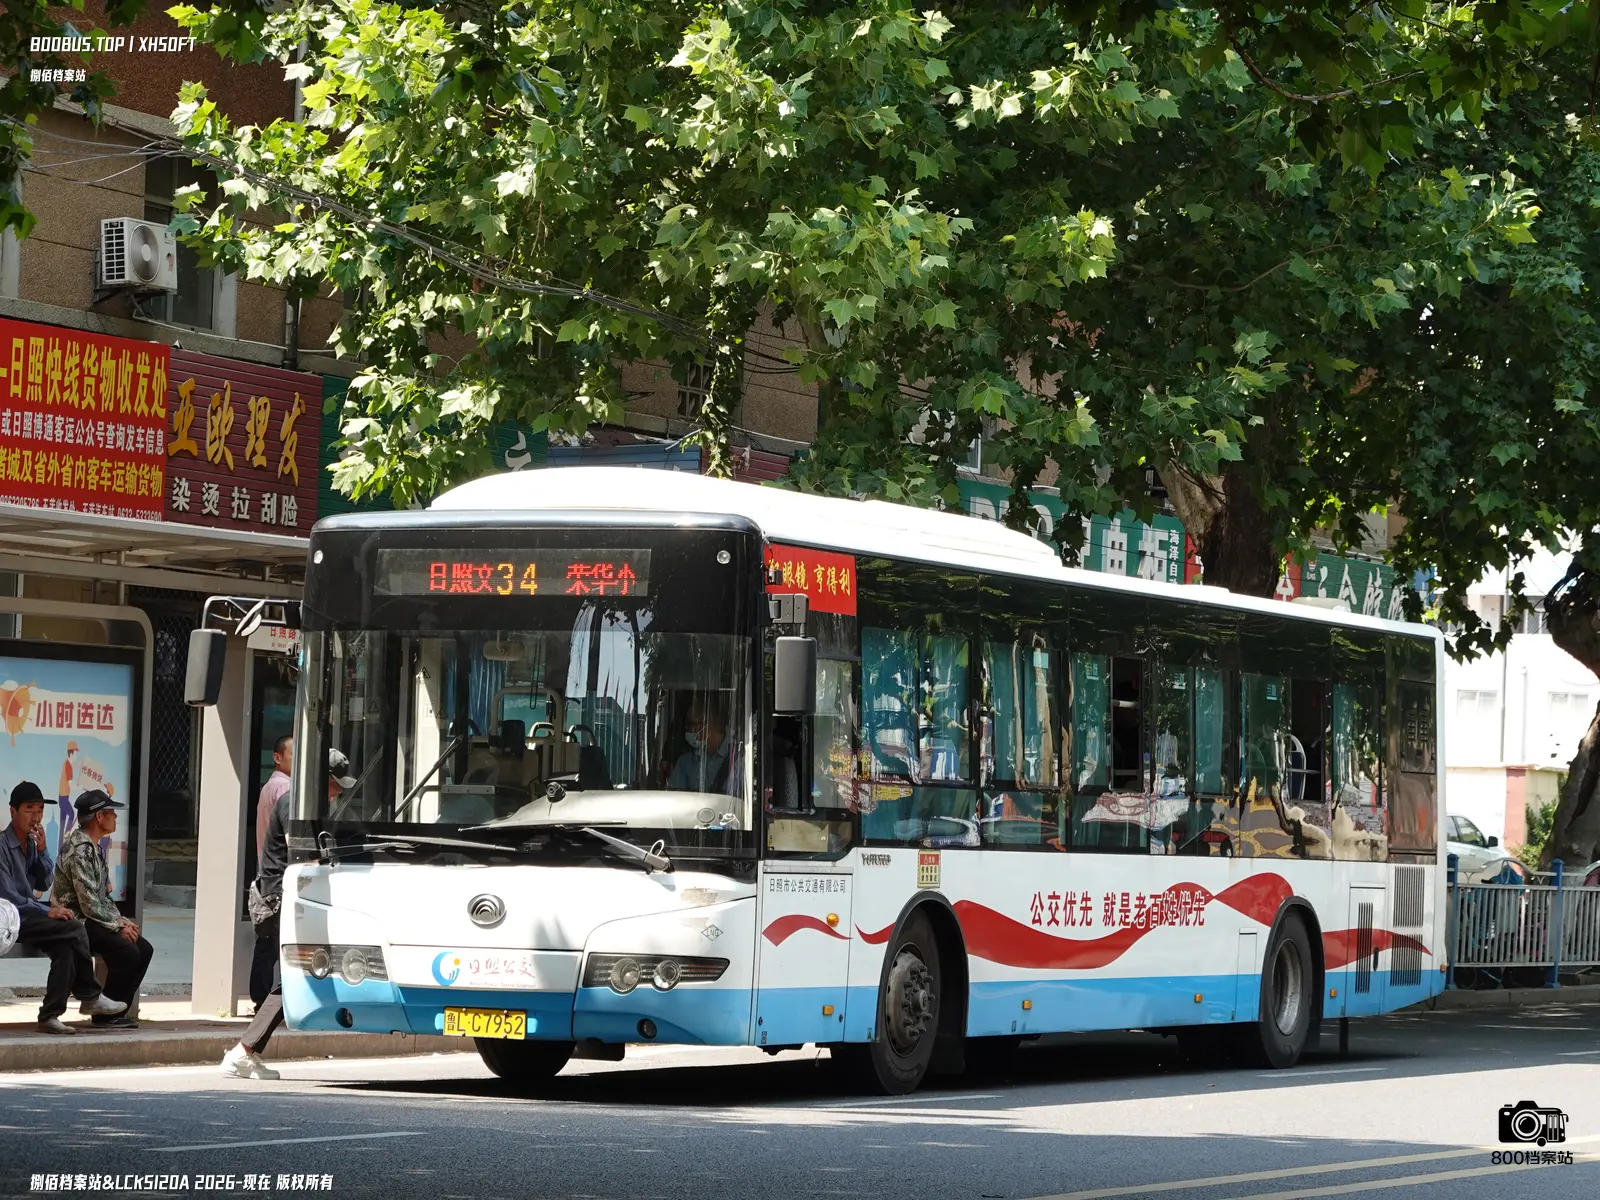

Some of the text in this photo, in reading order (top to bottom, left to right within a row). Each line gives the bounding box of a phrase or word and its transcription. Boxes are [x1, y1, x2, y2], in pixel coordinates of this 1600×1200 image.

[167, 377, 306, 487] 亚欧理发
[497, 563, 538, 595] 34
[813, 564, 851, 596] 亨得利
[36, 700, 114, 730] 小时送达
[769, 878, 846, 893] 日照市公共交通有限公司
[1030, 890, 1205, 929] 公交优先 就是老百姓优先
